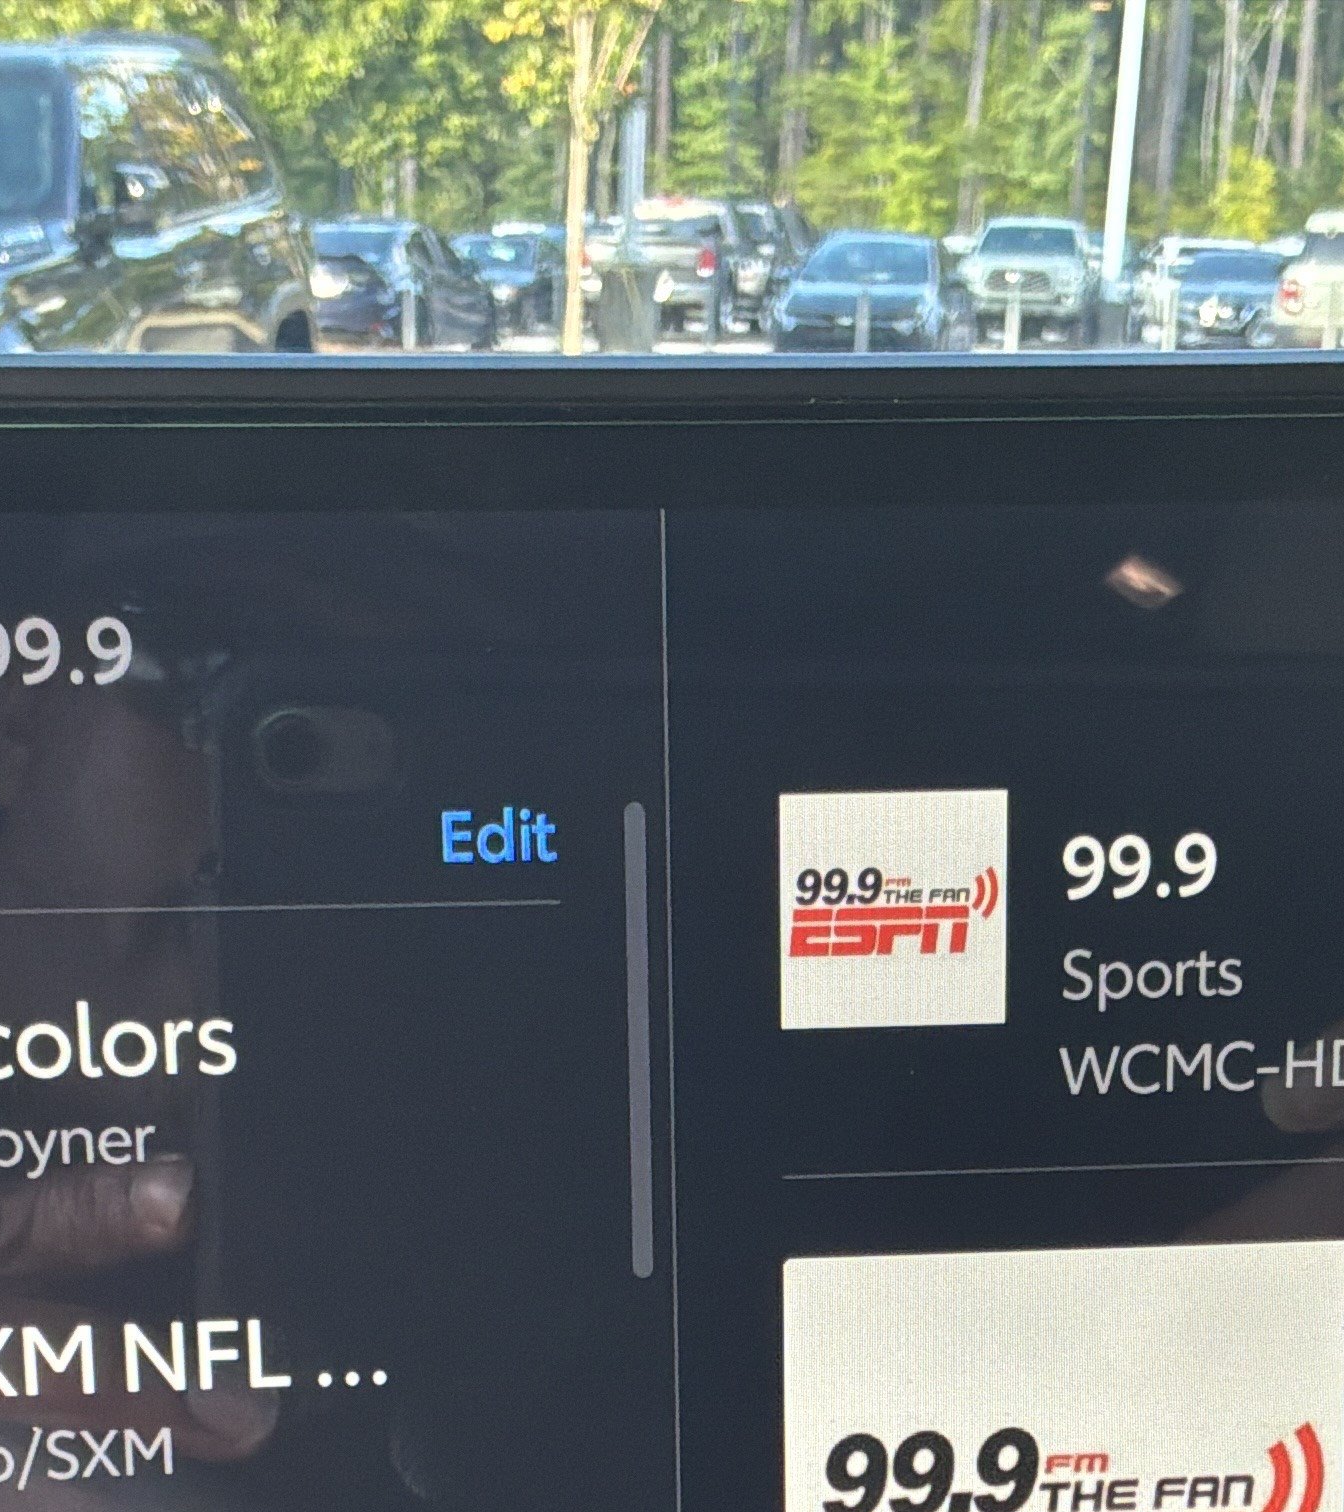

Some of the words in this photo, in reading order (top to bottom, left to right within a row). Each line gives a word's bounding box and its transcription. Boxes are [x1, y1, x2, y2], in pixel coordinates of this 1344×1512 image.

[441, 806, 558, 864] Edit
[796, 868, 882, 906] 99.9
[1062, 832, 1218, 901] 99.9
[884, 888, 922, 904] THE
[929, 887, 970, 903] FAN
[790, 905, 970, 957] ESPN
[1062, 948, 1243, 1013] Sports
[123, 1318, 292, 1393] NFL
[1045, 1453, 1109, 1474] FM
[1040, 1478, 1139, 1512] THE
[1152, 1474, 1255, 1510] FAN
